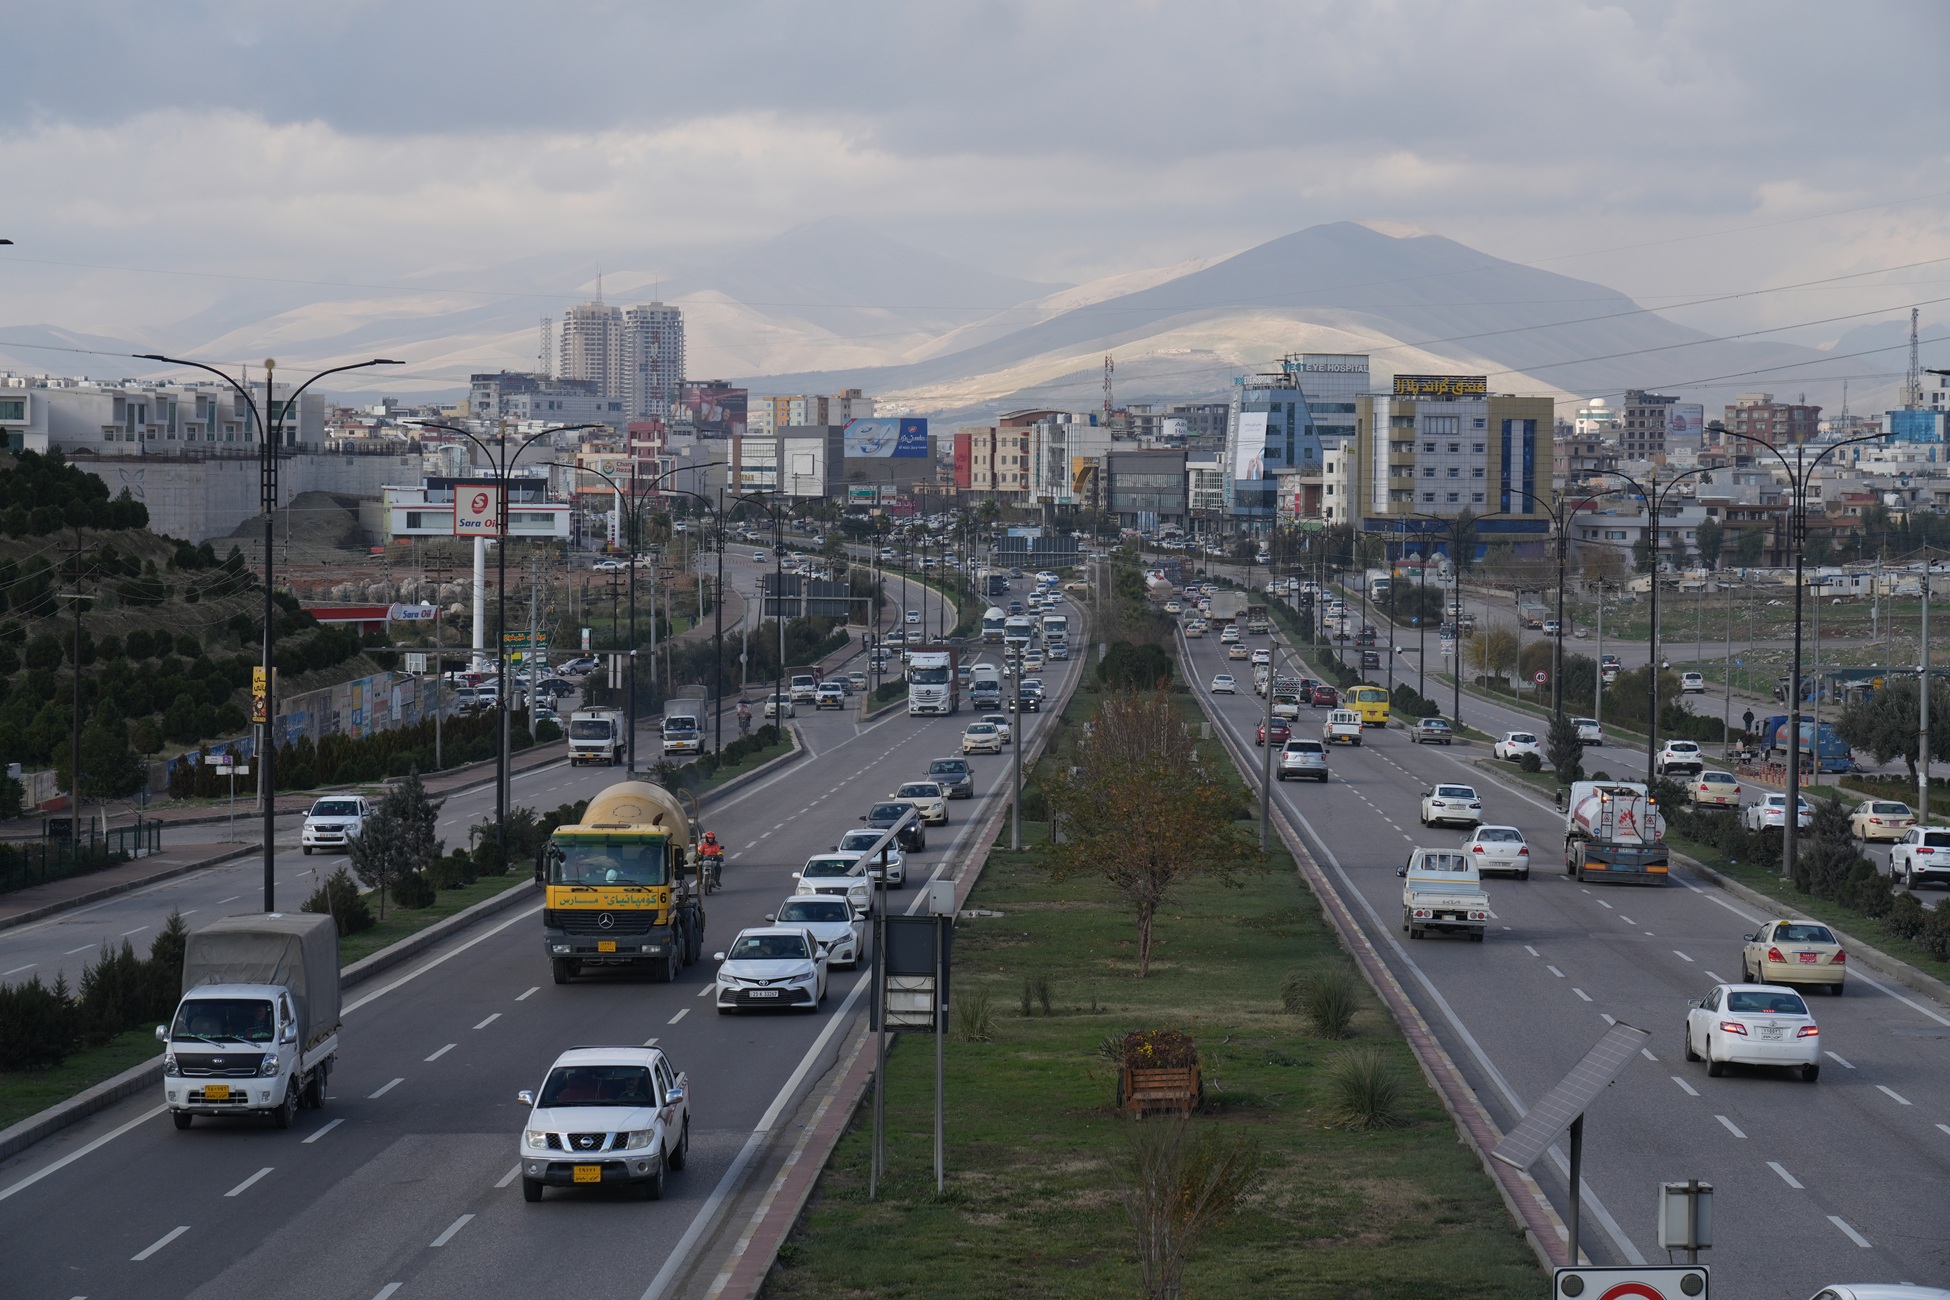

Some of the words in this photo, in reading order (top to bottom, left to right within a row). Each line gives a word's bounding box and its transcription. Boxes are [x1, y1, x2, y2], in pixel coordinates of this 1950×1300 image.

[1282, 363, 1306, 373] WEST
[1306, 363, 1325, 372] EYE
[1327, 364, 1369, 373] HOSPITAL
[459, 518, 481, 527] Sara
[402, 610, 419, 618] Sara
[421, 609, 432, 618] Oil
[659, 892, 667, 903] 6
